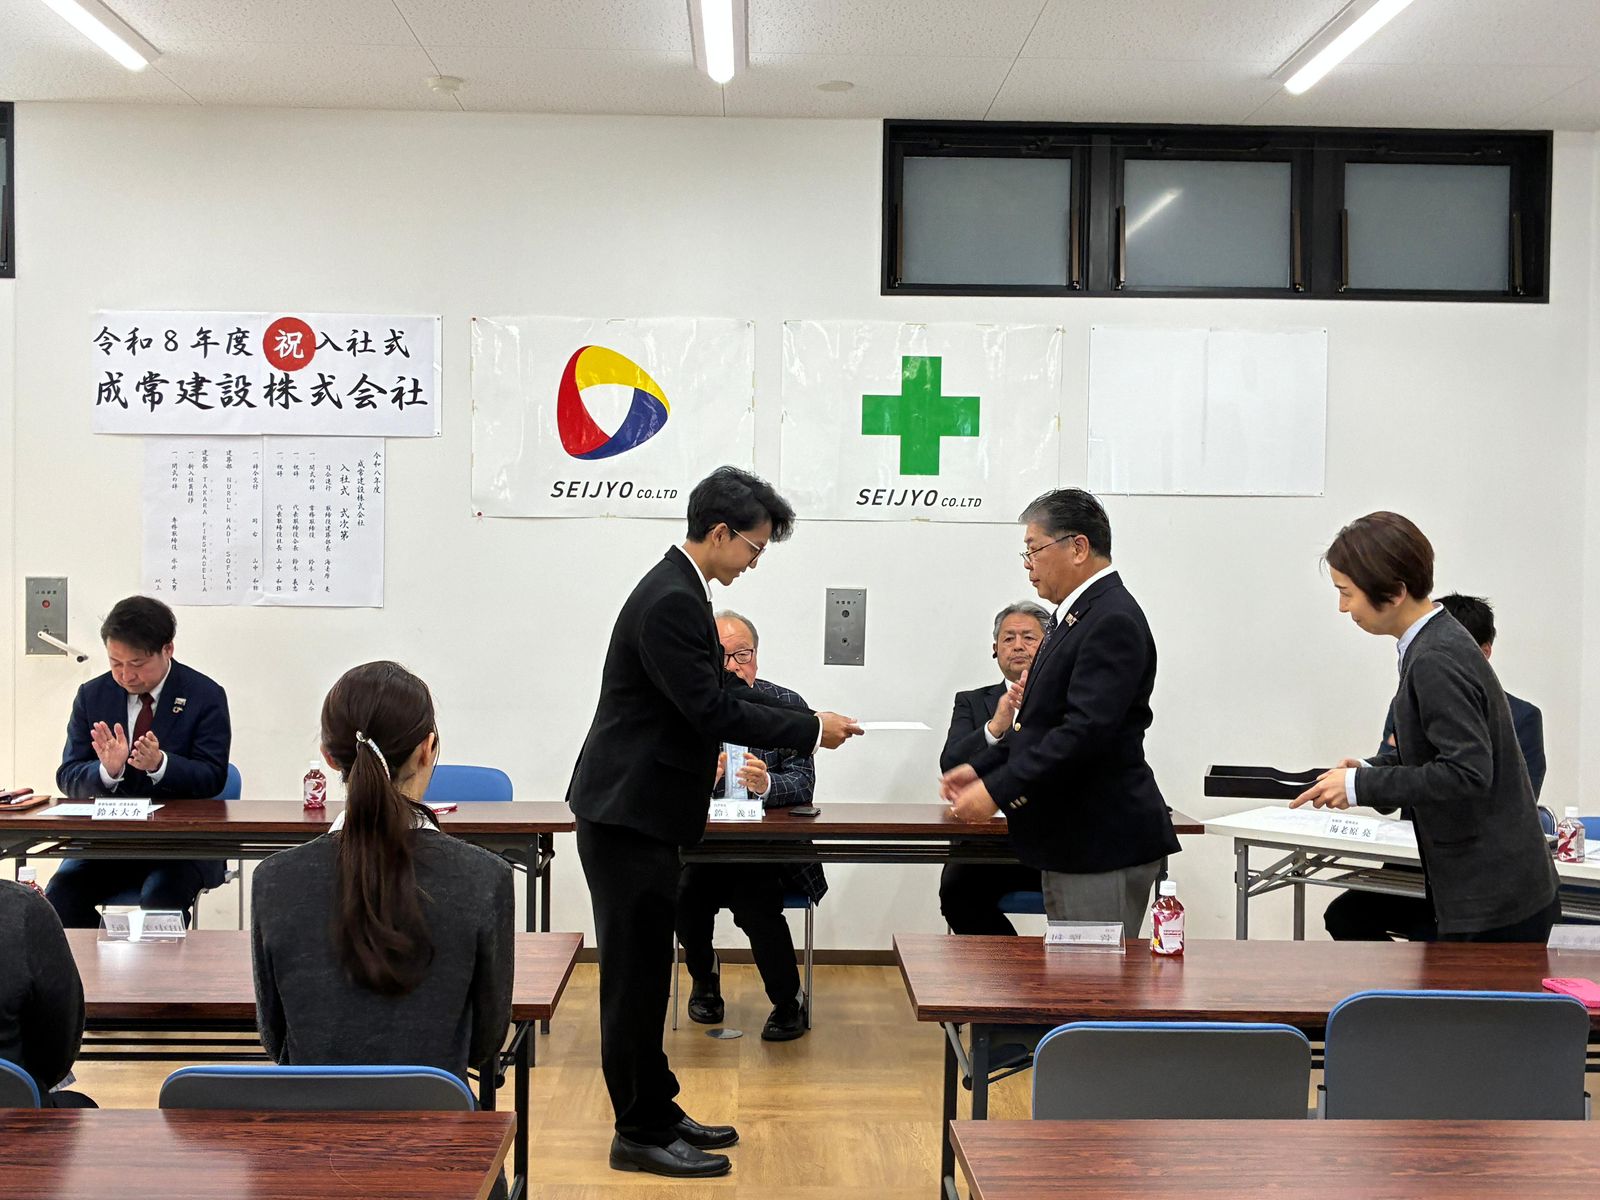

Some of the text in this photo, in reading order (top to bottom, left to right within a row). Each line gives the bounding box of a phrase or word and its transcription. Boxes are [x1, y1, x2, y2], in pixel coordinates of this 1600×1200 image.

[93, 325, 411, 360] 令和8年度 祝 入社式
[96, 371, 429, 413] 成常建設株式会社
[339, 464, 351, 496] 入社式
[550, 480, 678, 499] SEIJYO CO.LTD
[855, 488, 982, 508] SEIJYO CO.LTD
